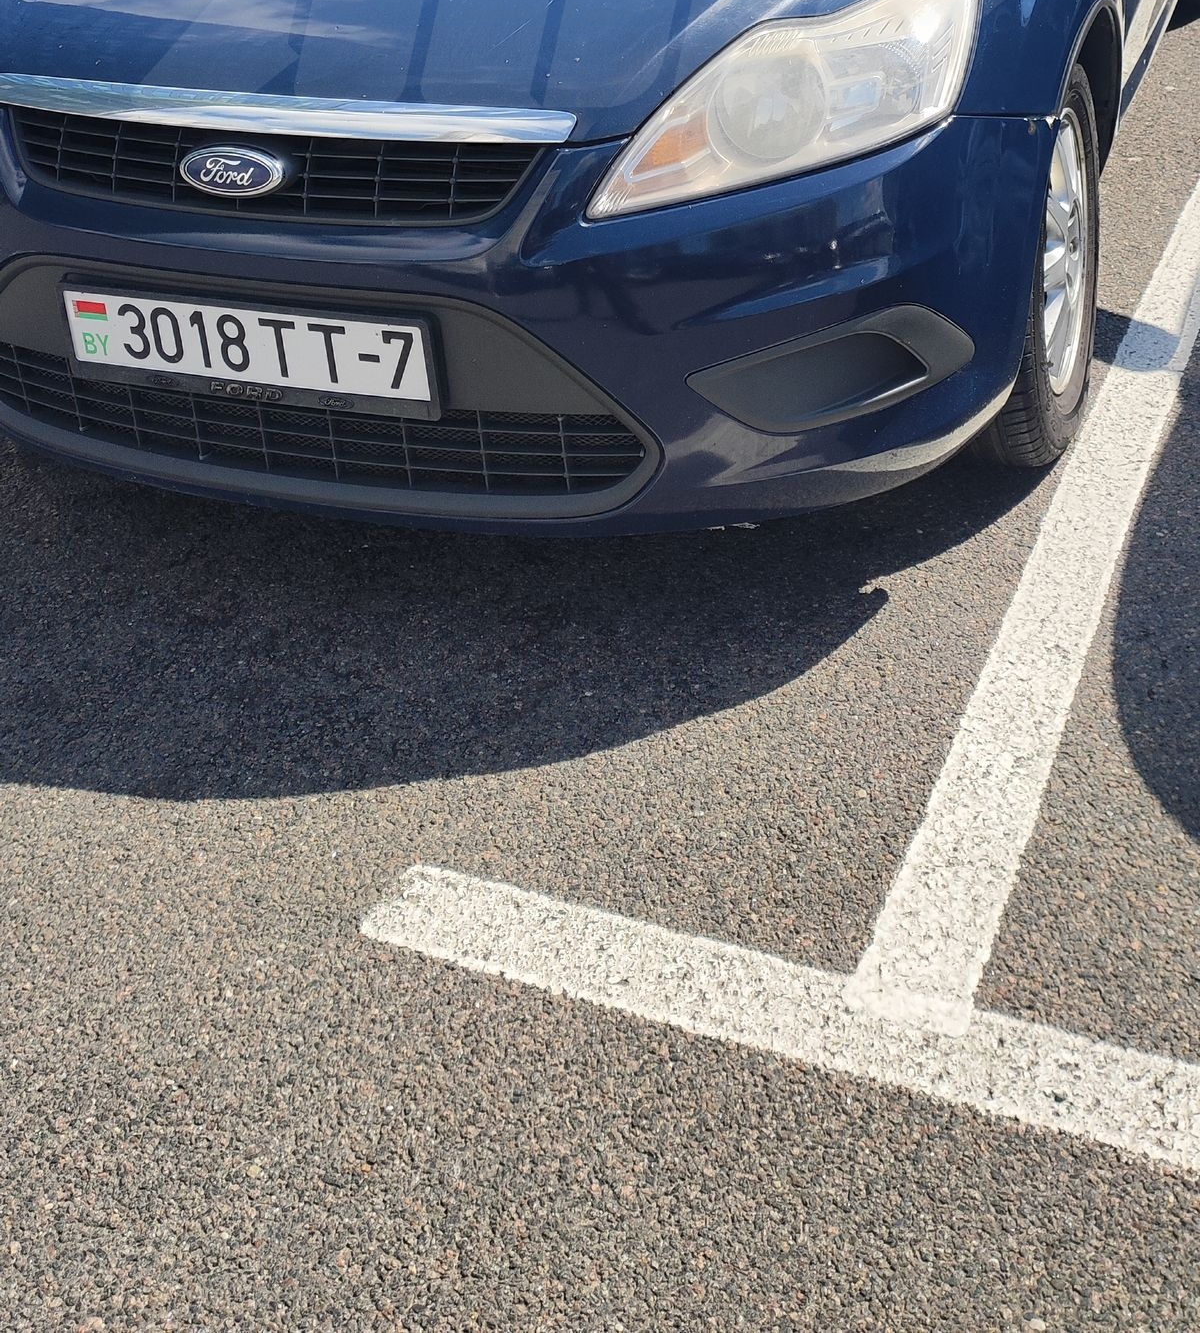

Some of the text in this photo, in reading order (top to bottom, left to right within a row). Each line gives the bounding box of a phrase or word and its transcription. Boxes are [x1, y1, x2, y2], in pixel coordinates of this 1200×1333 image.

[200, 157, 254, 186] Ford
[83, 332, 110, 356] BY
[210, 381, 283, 402] FORD
